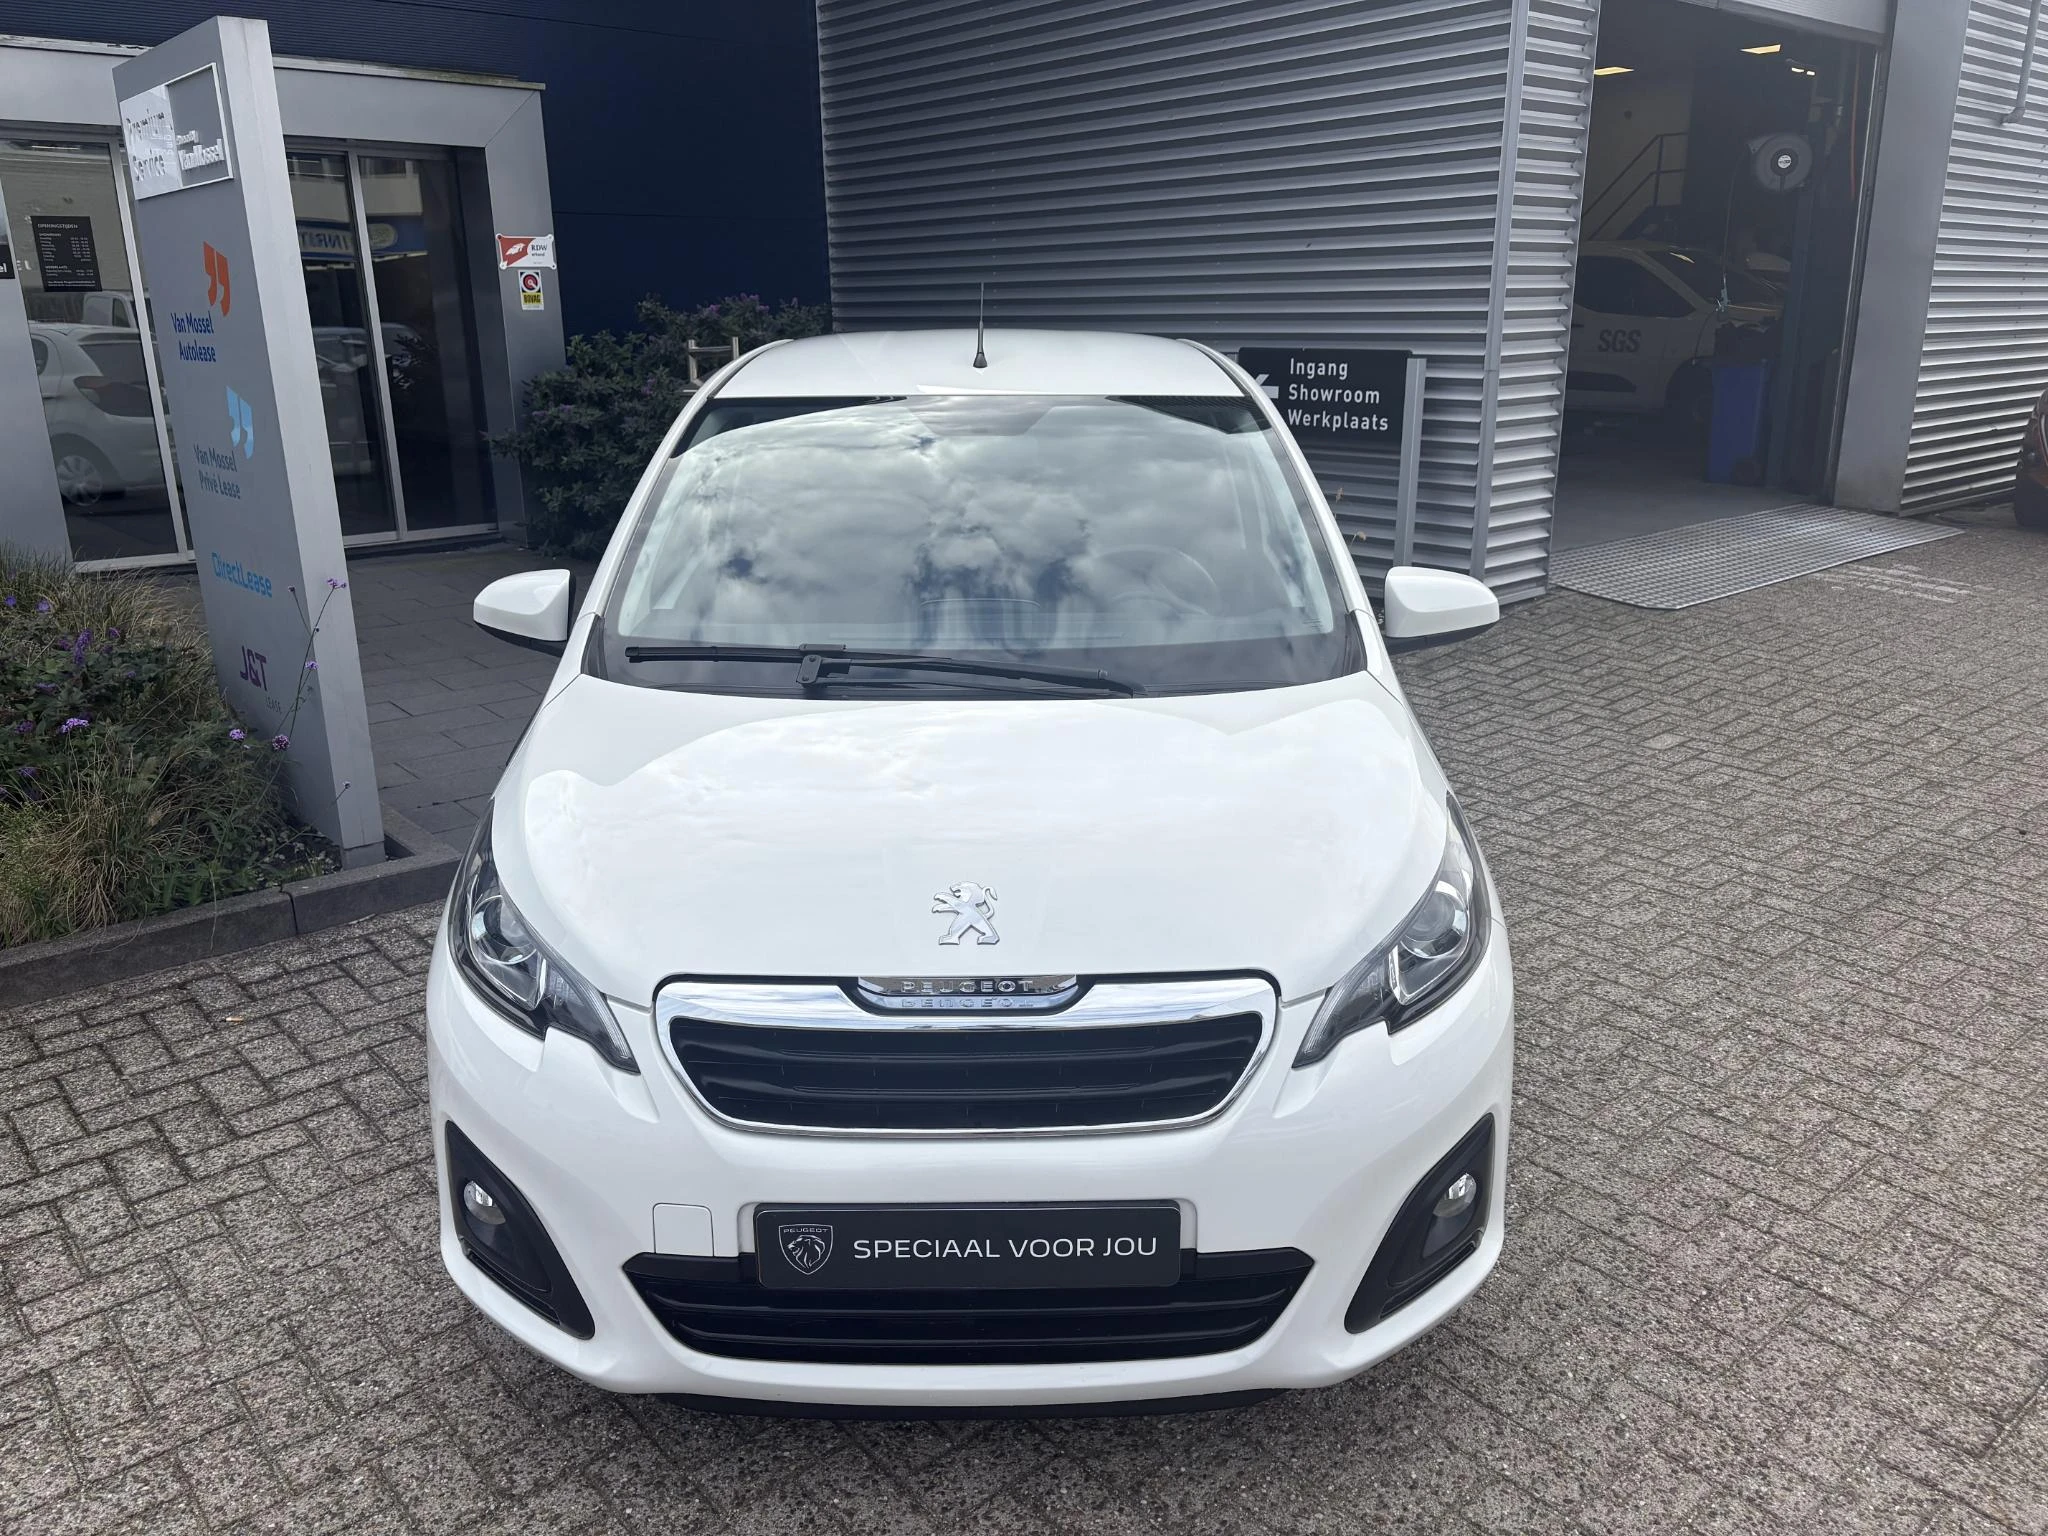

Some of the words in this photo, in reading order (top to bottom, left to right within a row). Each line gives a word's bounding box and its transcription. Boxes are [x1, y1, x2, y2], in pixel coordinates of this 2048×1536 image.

[523, 293, 542, 304] BOVAG
[170, 312, 186, 334] Van
[185, 310, 215, 334] Mossel
[178, 339, 217, 363] Autolease
[1597, 328, 1642, 353] SGS
[1290, 357, 1348, 380] Ingang
[1288, 383, 1380, 404] Showroom
[1287, 408, 1389, 432] Werkplaats
[193, 443, 210, 467] Van
[208, 447, 238, 473] Mossel
[217, 472, 241, 500] Lease
[211, 551, 273, 598] DirectLease
[901, 979, 1034, 994] PEUGEOT
[853, 1238, 1000, 1260] SPECIAAL
[1008, 1237, 1095, 1258] VOOR
[1101, 1236, 1158, 1257] JOU
